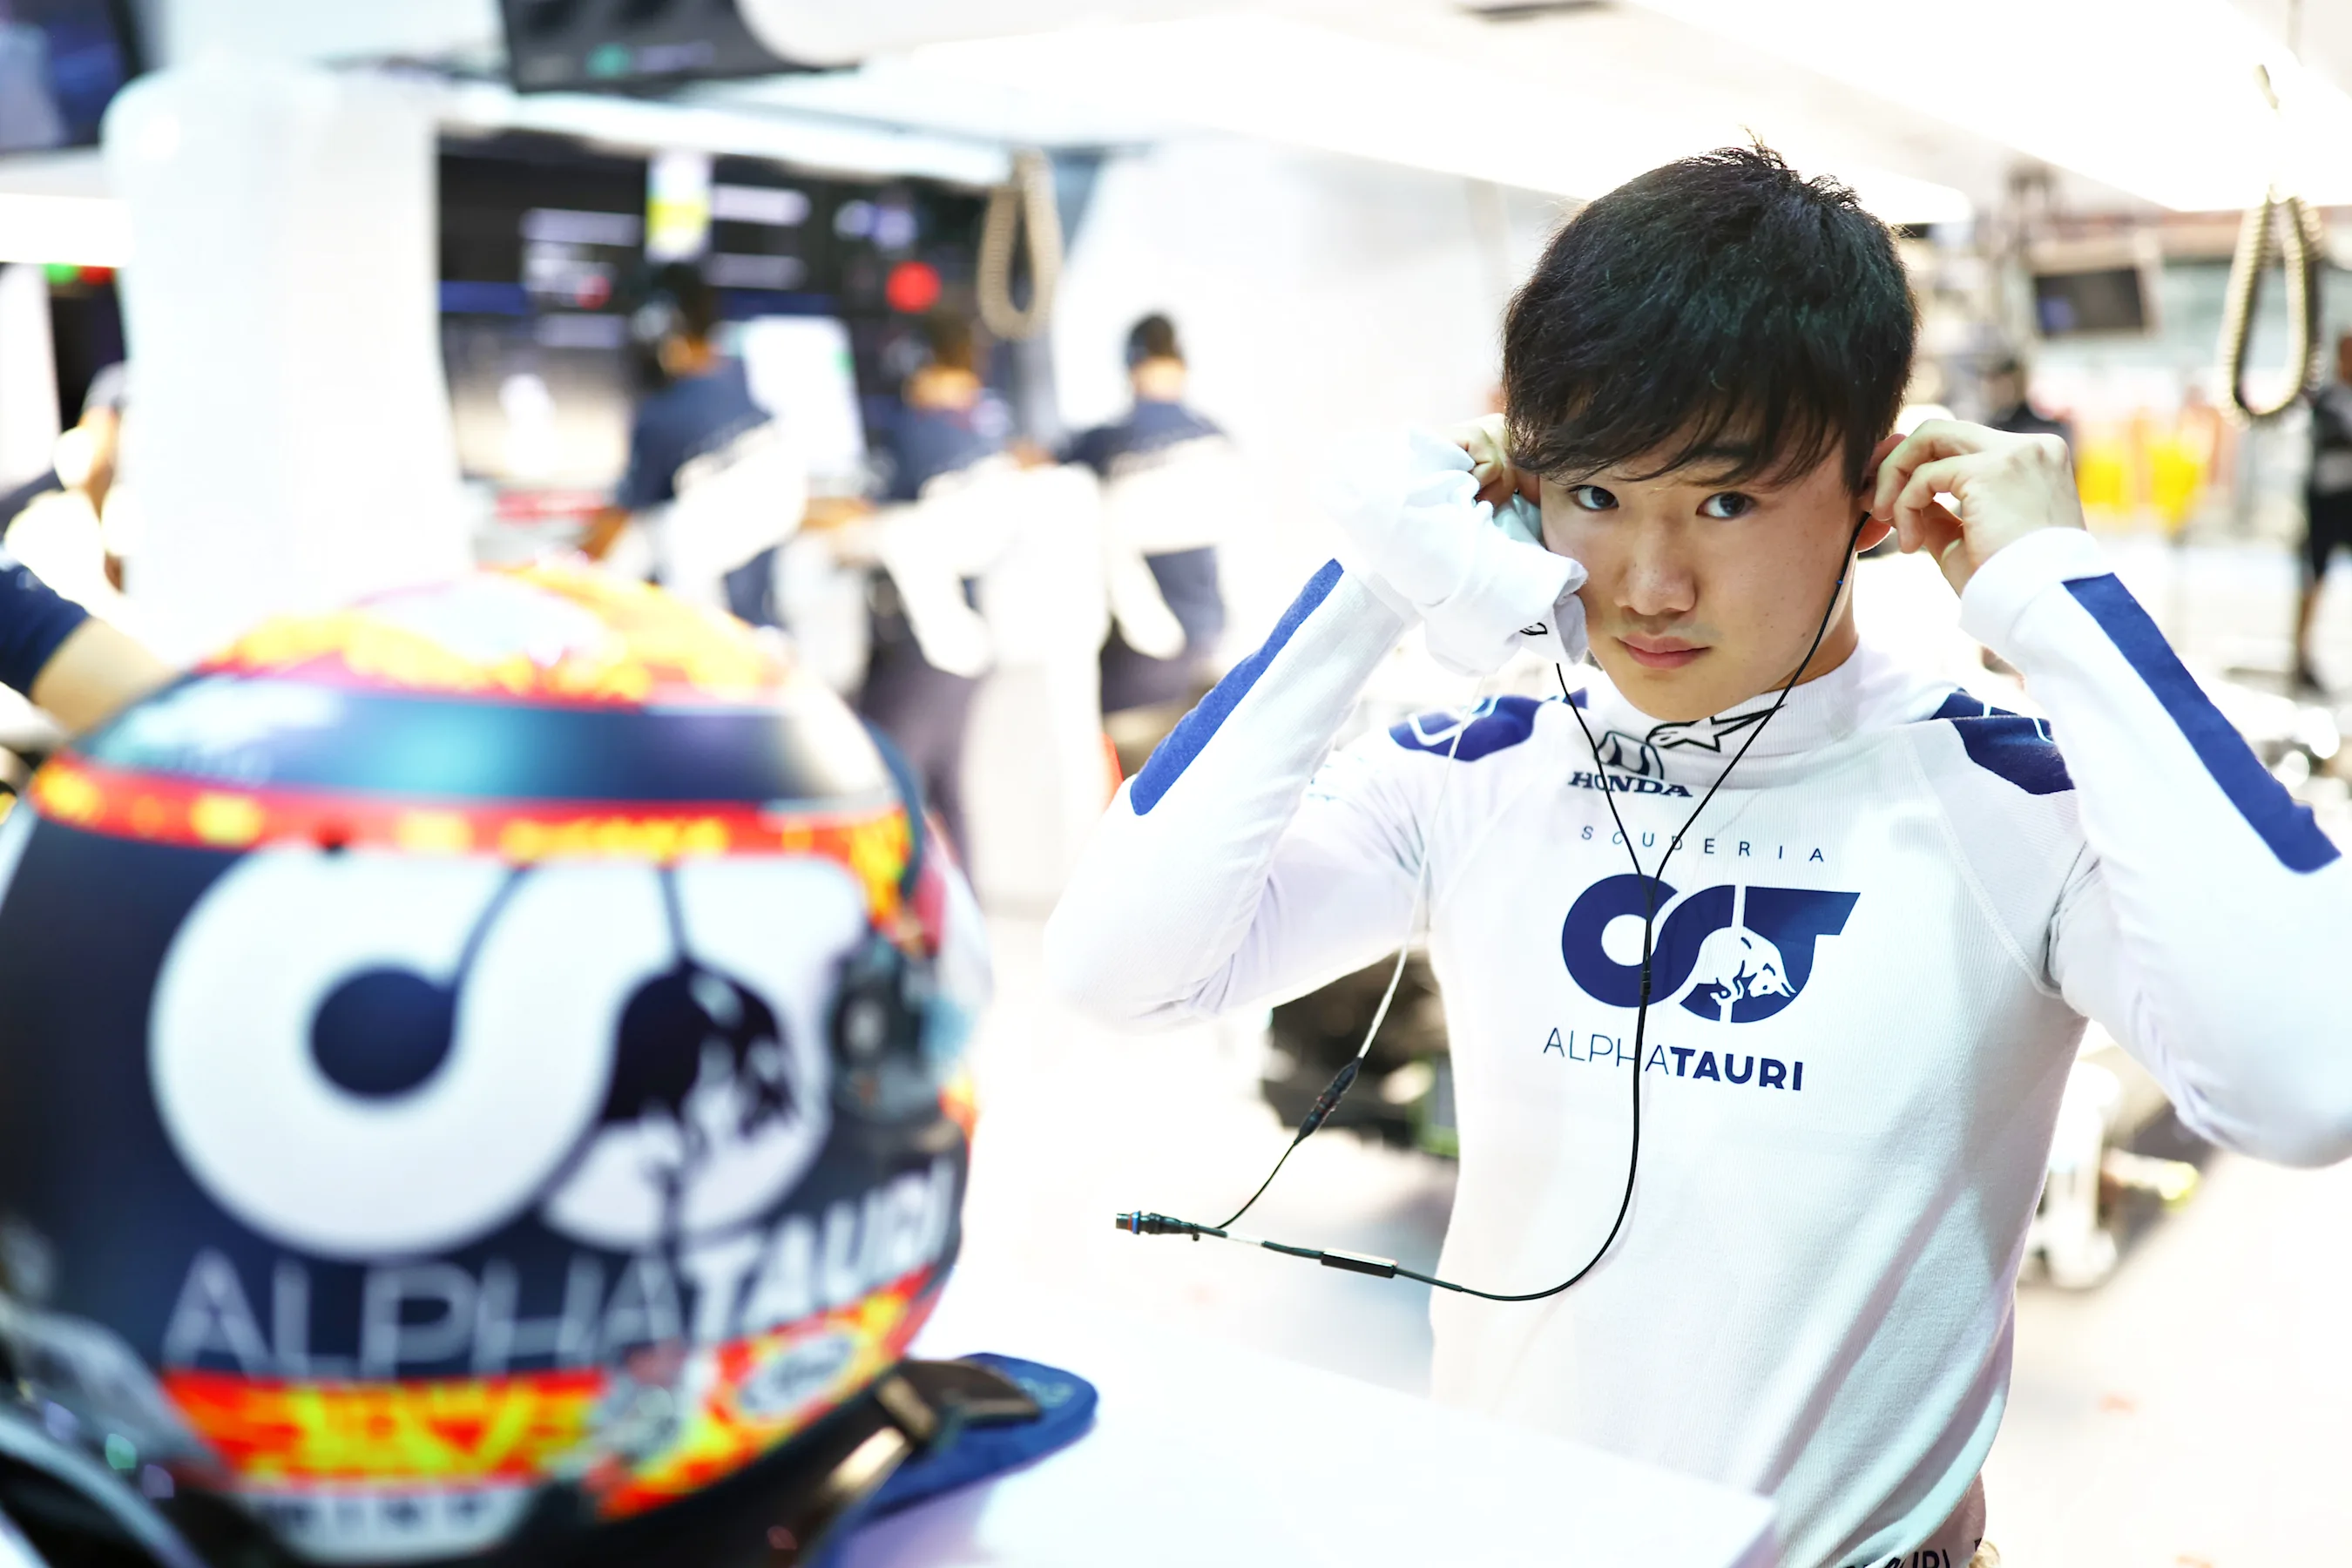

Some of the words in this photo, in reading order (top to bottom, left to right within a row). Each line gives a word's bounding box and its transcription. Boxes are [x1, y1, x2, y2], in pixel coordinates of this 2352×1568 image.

[1568, 770, 1693, 798] HONDA
[1581, 826, 1825, 862] SCUDERIA
[1543, 1027, 1804, 1092] ALPHATAURI
